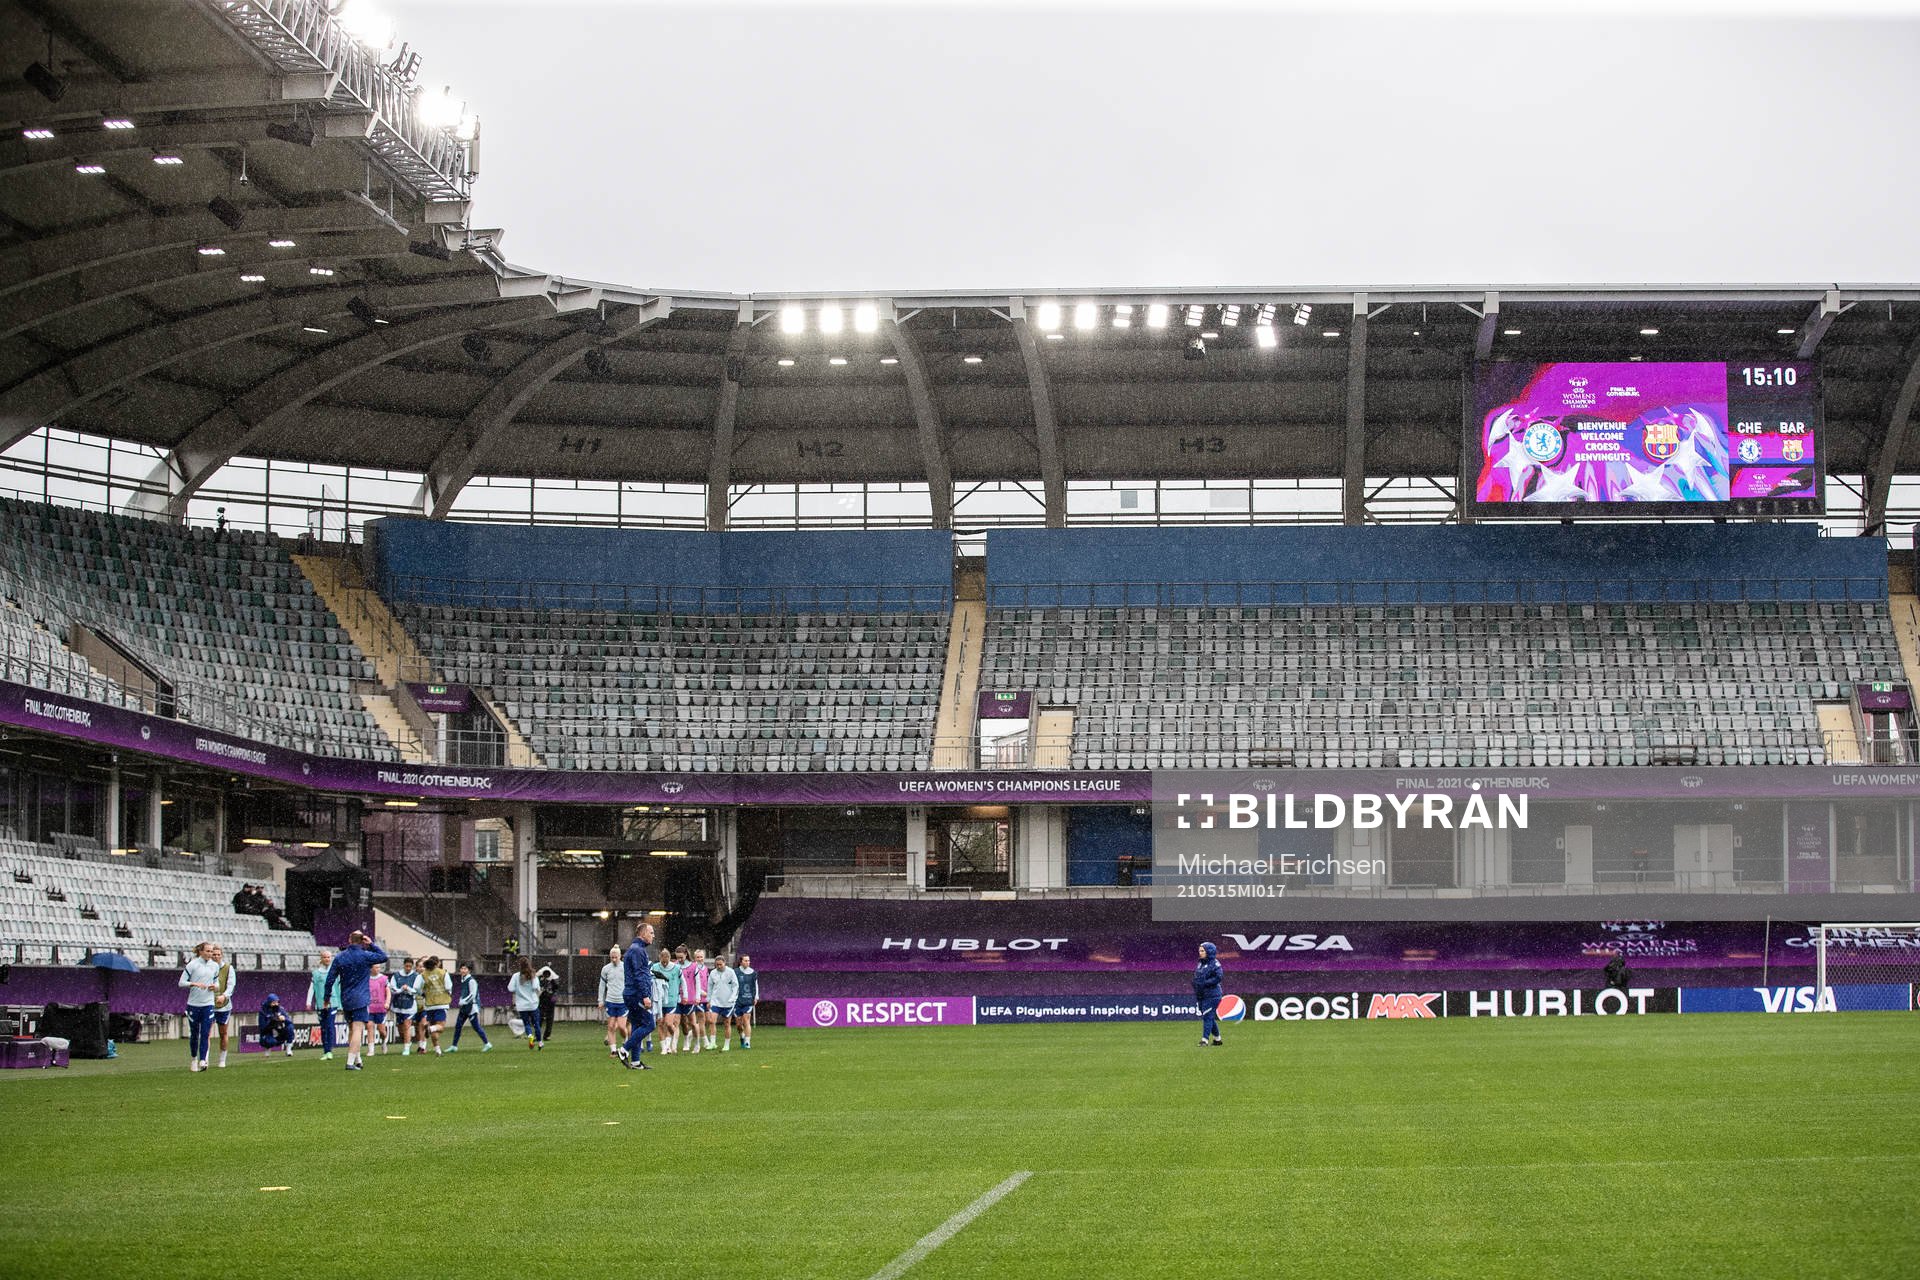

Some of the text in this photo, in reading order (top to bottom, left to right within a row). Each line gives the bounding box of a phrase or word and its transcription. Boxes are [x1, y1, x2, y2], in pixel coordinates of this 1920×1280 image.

[1742, 367, 1797, 386] 15:10
[1577, 422, 1627, 431] BIENVENUE
[1737, 422, 1762, 434] CHE
[1780, 422, 1805, 434] BAR
[1581, 432, 1624, 441] WELCOME
[1585, 442, 1620, 451] CROESO
[1575, 452, 1631, 461] BENVINGUTS
[25, 699, 42, 716] FINAL
[55, 706, 91, 728] GOTHENBURG
[377, 771, 492, 789] FINAL 2021 GOTHENBURG
[1396, 778, 1435, 789] FINAL
[1437, 778, 1462, 789] 2021
[1833, 774, 1867, 785] UEFA
[899, 780, 1121, 792] UEFA WOMEN'S CHAMPIONS LEAGUE
[1808, 927, 1909, 937] FINAL
[882, 937, 1068, 951] HUBLOT
[1221, 934, 1353, 951] VISA
[1582, 938, 1697, 949] WOMEN'S
[1470, 988, 1654, 1017] HUBLOT
[1753, 986, 1838, 1013] VISA
[846, 1001, 948, 1023] RESPECT
[980, 1006, 1012, 1016] UEFA
[1016, 1005, 1087, 1017] Playmakers
[1090, 1004, 1139, 1016] inspired
[1142, 1004, 1158, 1017] by
[1255, 992, 1442, 1021] pepsi MAX
